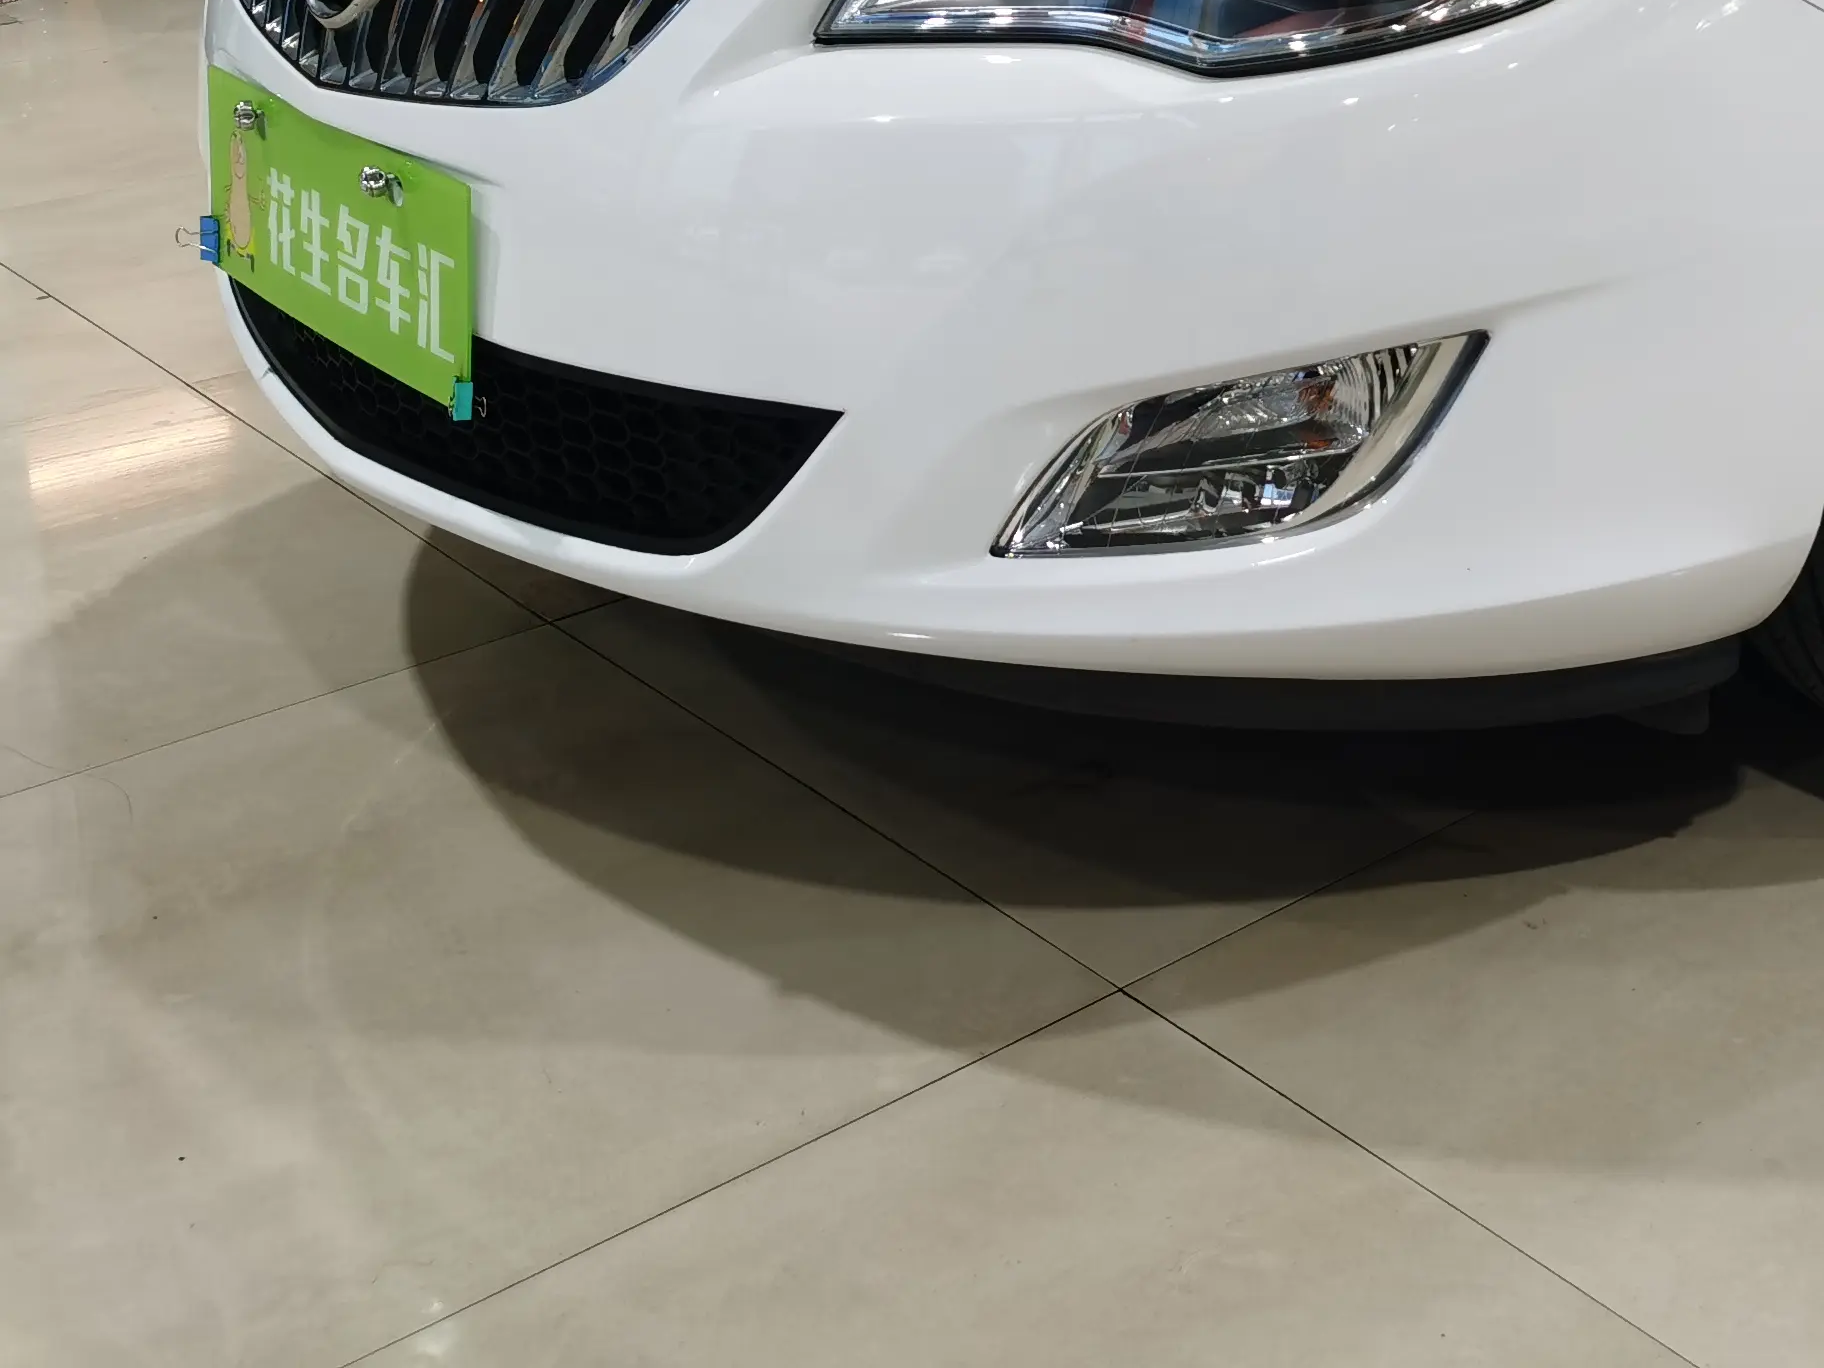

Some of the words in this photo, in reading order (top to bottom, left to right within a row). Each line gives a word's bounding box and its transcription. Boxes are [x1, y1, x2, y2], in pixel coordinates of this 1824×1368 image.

[265, 166, 456, 365] 花生名车汇
